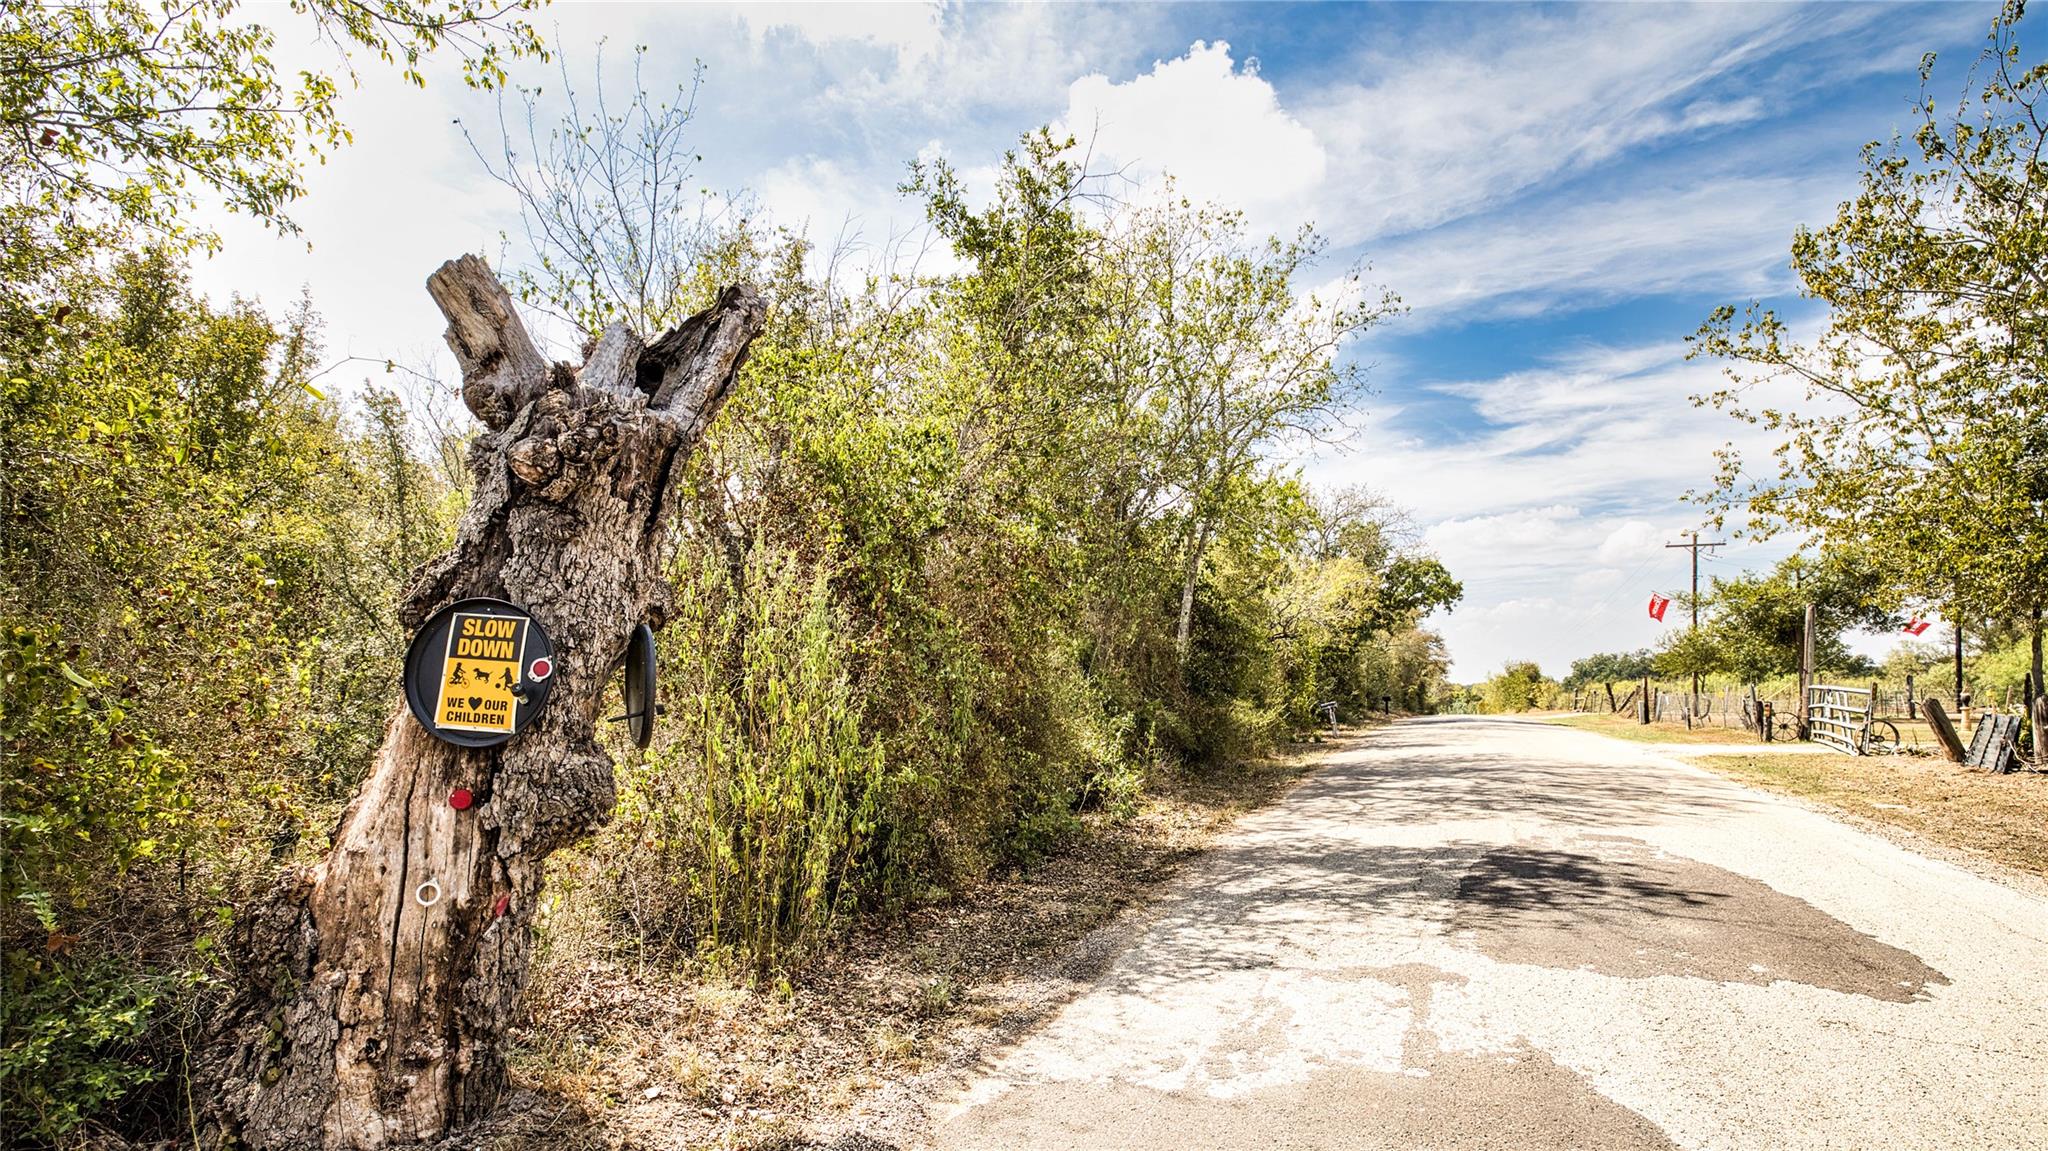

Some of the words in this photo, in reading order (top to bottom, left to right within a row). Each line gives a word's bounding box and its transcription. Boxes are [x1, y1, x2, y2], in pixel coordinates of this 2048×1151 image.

[462, 618, 516, 638] SLOW
[457, 639, 514, 659] DOWN
[447, 697, 465, 708] WE
[484, 699, 508, 711] OUR
[446, 711, 505, 725] CHILDREN
